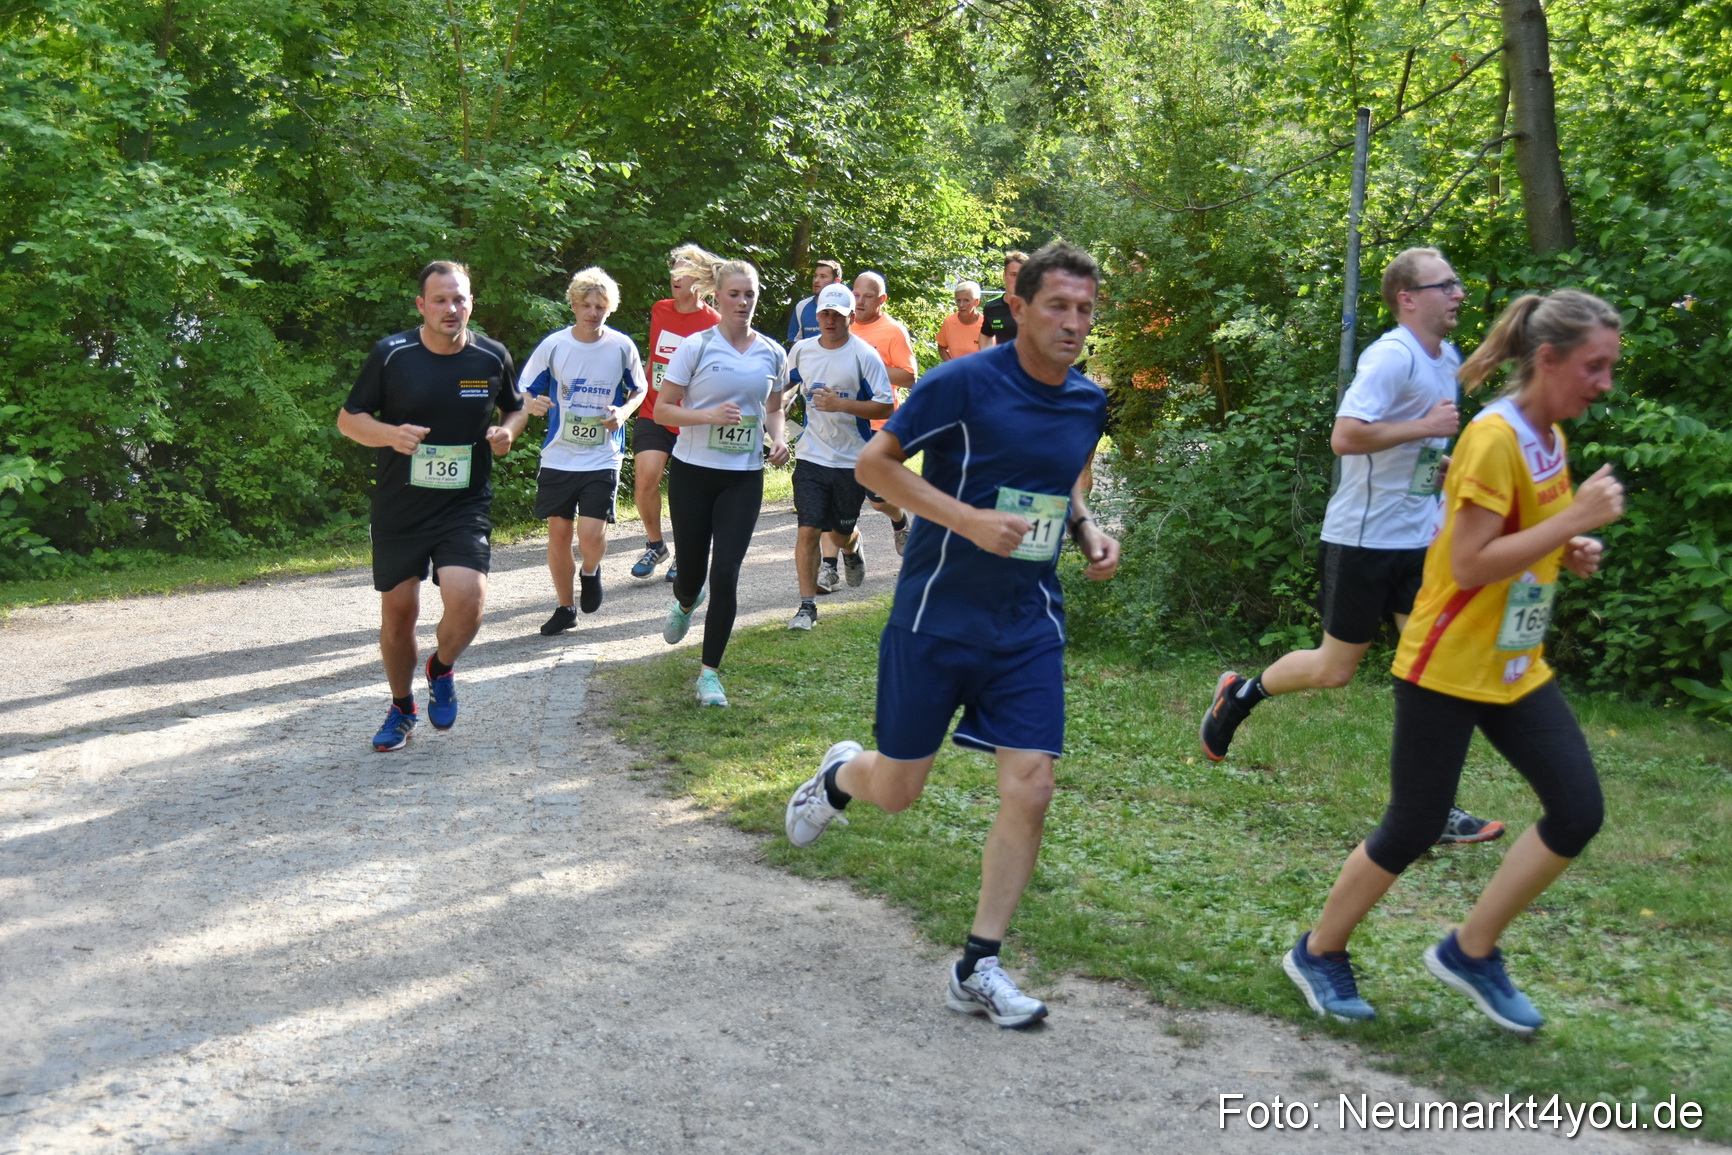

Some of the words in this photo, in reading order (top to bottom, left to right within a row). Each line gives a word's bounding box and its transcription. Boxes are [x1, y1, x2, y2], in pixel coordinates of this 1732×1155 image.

[572, 425, 597, 438] 820
[717, 426, 752, 443] 1471
[425, 460, 458, 477] 136
